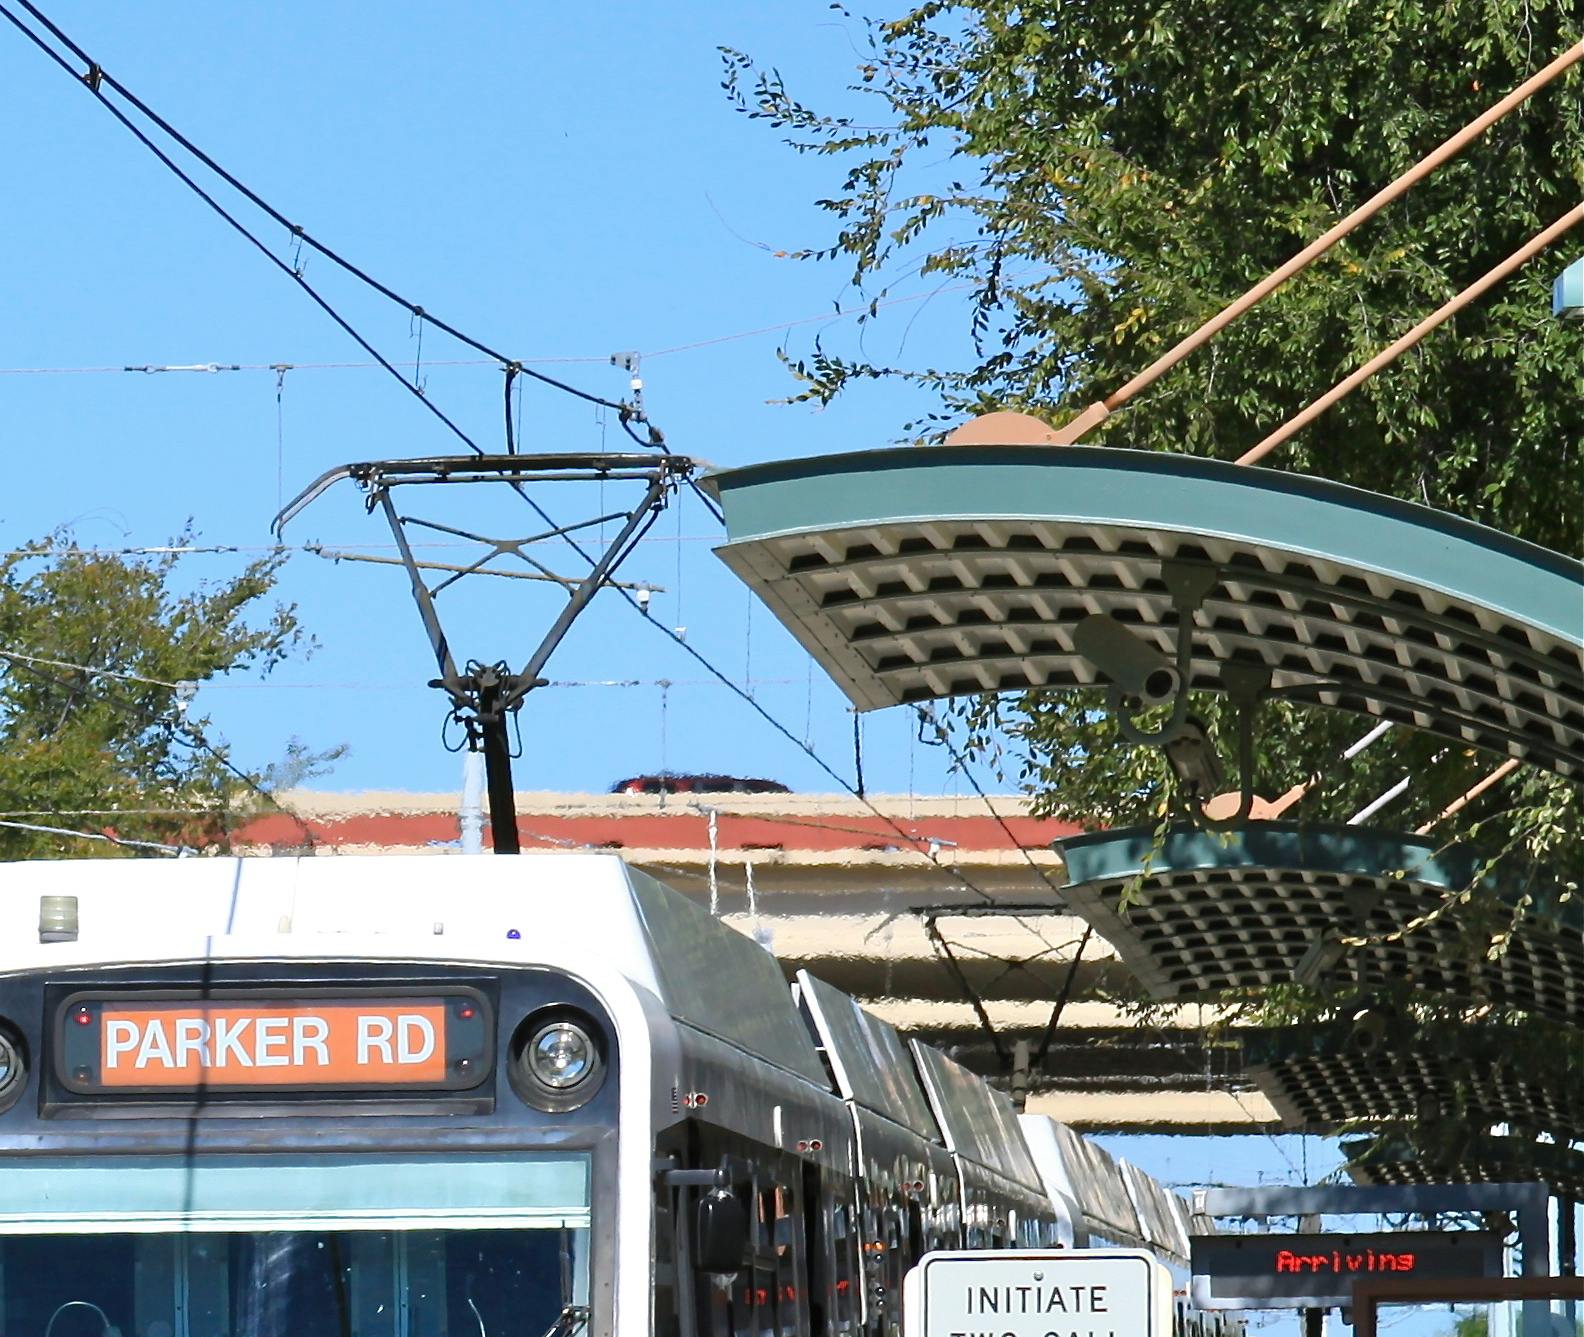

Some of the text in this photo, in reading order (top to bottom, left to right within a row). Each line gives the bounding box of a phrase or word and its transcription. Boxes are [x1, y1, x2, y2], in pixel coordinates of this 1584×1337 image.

[105, 1013, 437, 1068] PARKER RD
[1275, 1248, 1416, 1273] Arriving
[967, 1286, 1109, 1314] INITIATE
